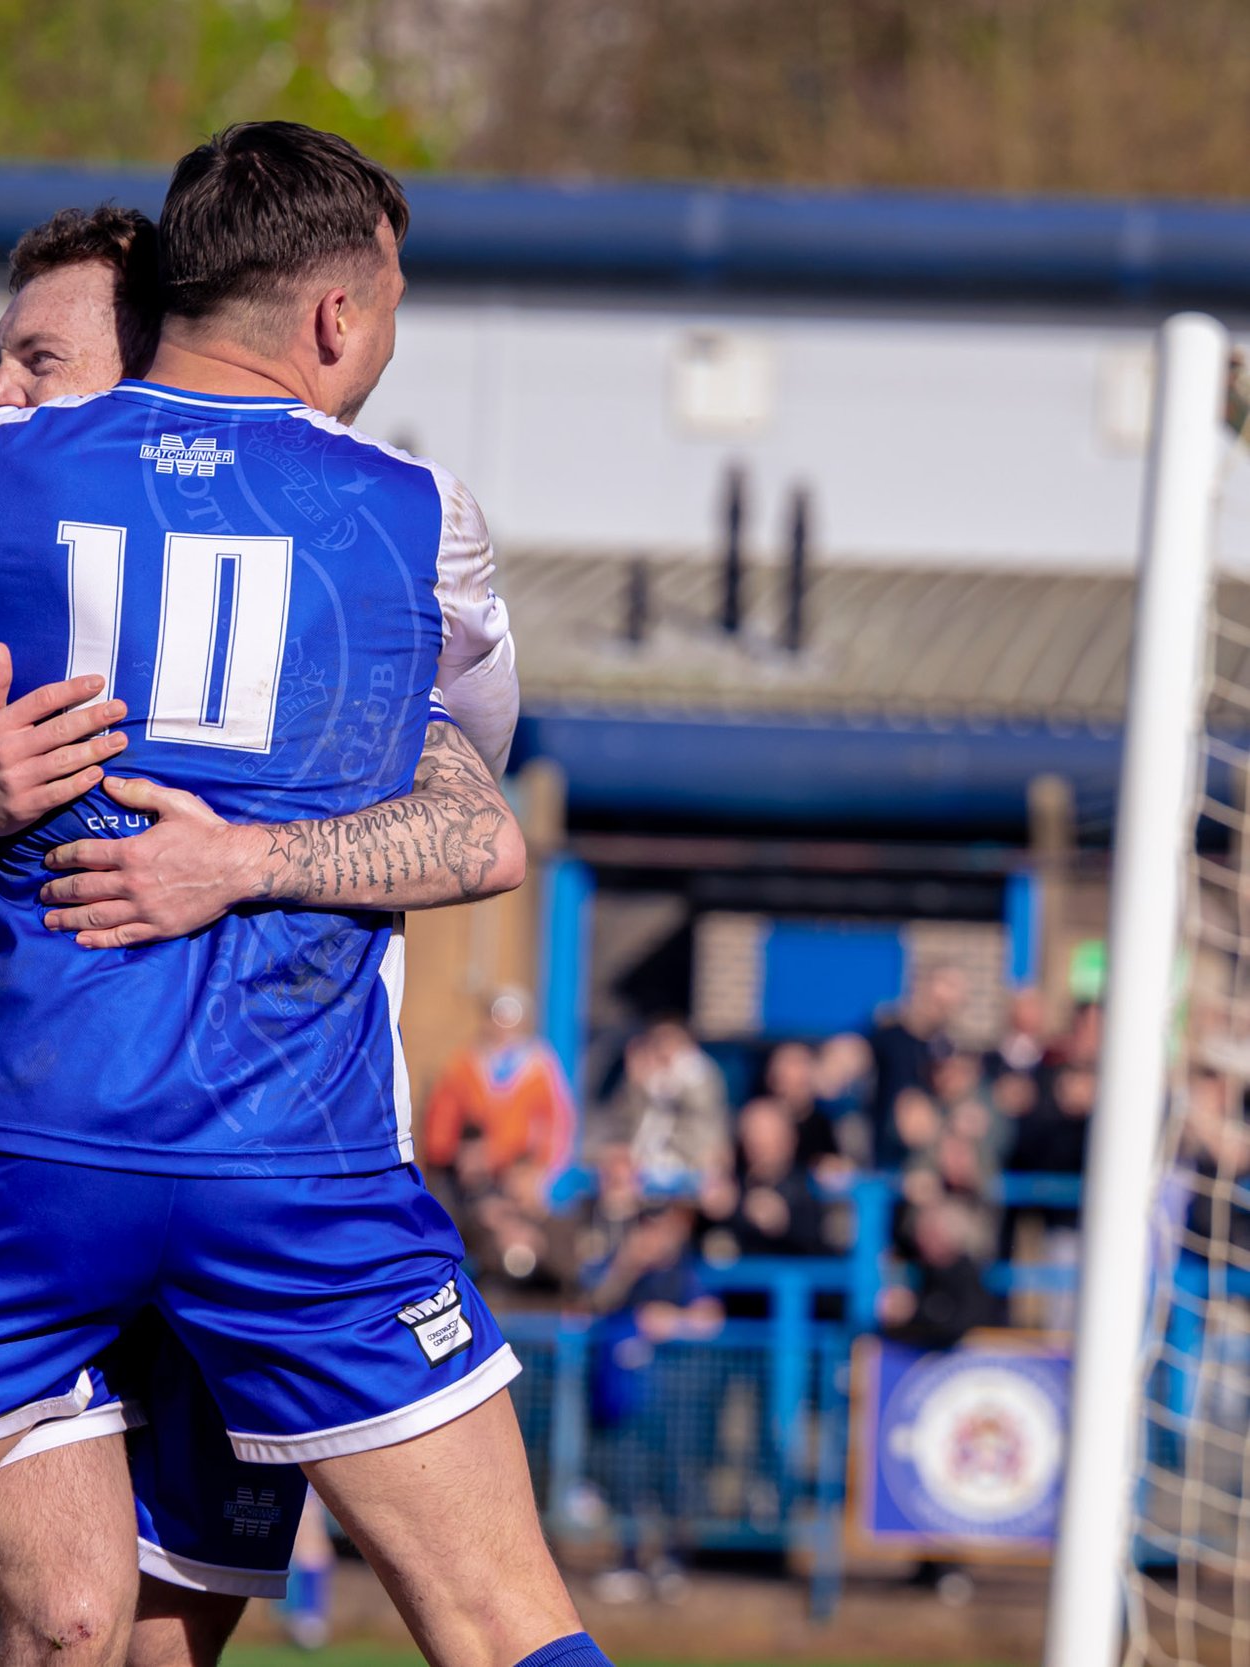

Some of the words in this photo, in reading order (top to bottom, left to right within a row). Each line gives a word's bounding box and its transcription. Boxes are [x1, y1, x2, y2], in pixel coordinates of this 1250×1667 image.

[143, 446, 232, 463] MATCHWINNER
[297, 496, 325, 523] LAB
[57, 520, 293, 755] 10
